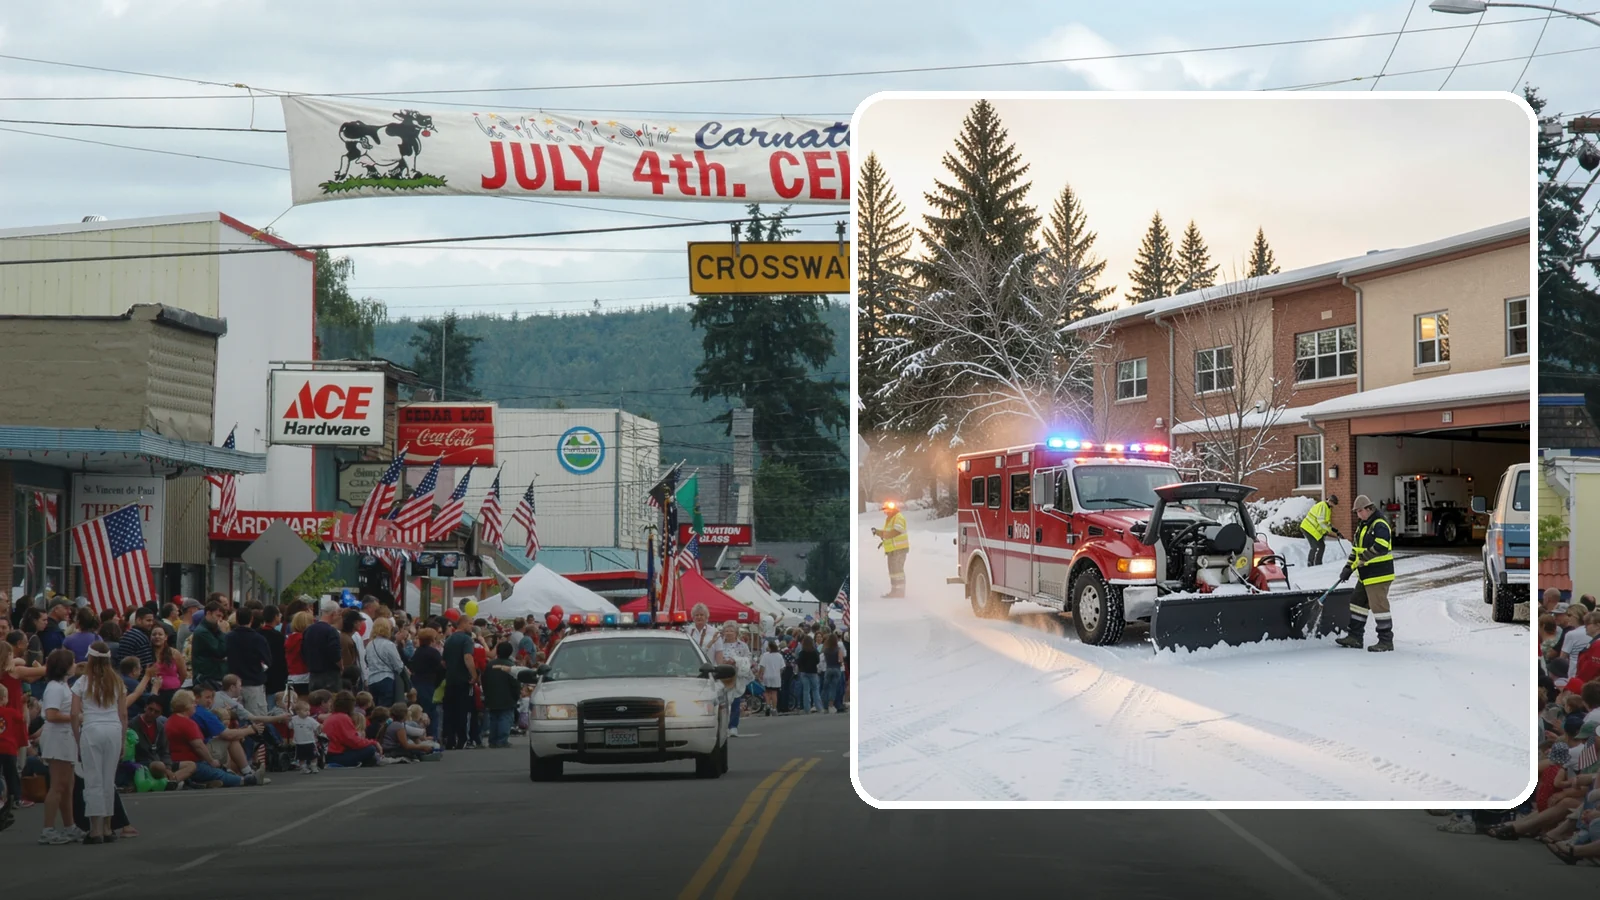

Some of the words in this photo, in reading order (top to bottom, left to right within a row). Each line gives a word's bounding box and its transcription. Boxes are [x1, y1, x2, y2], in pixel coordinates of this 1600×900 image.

[481, 141, 604, 193] JULY
[632, 150, 746, 197] 4th.
[696, 254, 850, 281] CROSSWA
[283, 380, 373, 420] ACE
[406, 409, 452, 422] CEDAR
[284, 421, 370, 437] Hardware
[416, 428, 476, 447] Coca-Cola
[353, 467, 385, 481] Simpl
[95, 485, 125, 495] Vincent
[126, 486, 136, 494] de
[137, 486, 155, 495] Paul
[688, 526, 741, 535] CRNATION
[699, 535, 730, 544] GLASS
